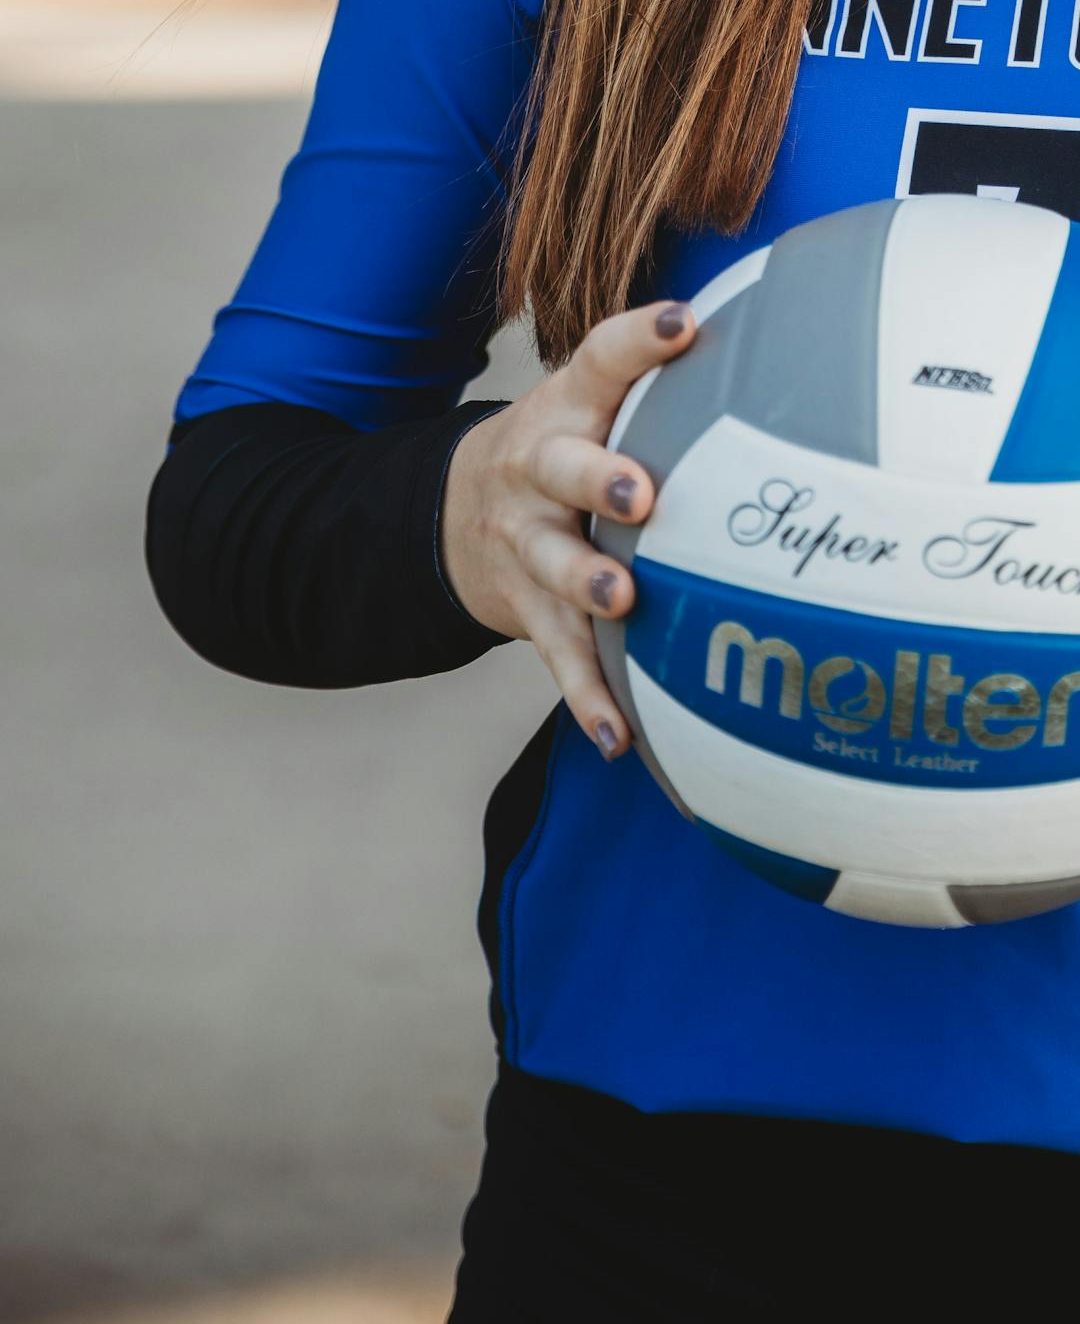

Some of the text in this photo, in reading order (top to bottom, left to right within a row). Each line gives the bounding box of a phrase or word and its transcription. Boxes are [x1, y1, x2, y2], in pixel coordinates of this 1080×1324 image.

[727, 478, 898, 578] Super
[812, 732, 980, 773] Select Leather
